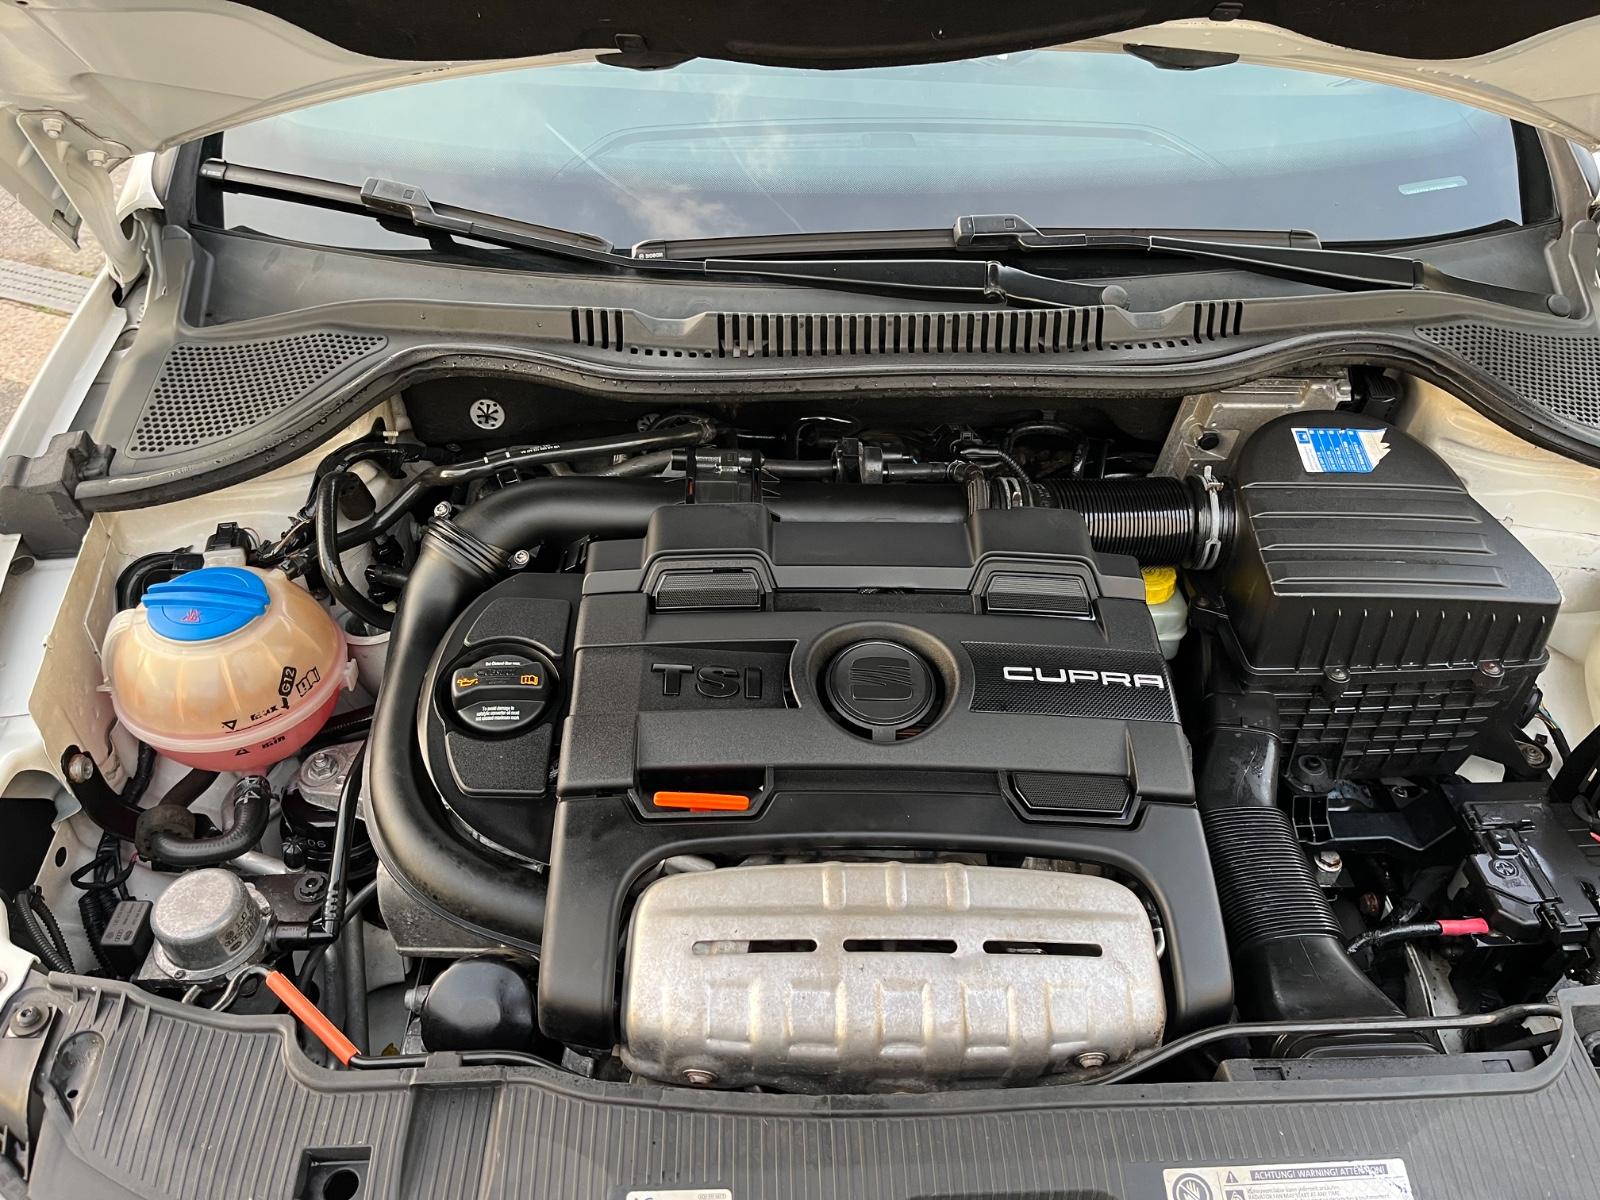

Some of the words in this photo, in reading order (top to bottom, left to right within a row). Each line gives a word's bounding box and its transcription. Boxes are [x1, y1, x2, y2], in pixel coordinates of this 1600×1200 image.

[281, 668, 295, 693] G12
[651, 663, 763, 698] TSI
[1003, 666, 1165, 689] CUPRA
[1254, 1170, 1296, 1180] ACHTUNG!
[1296, 1168, 1339, 1178] WARNING!
